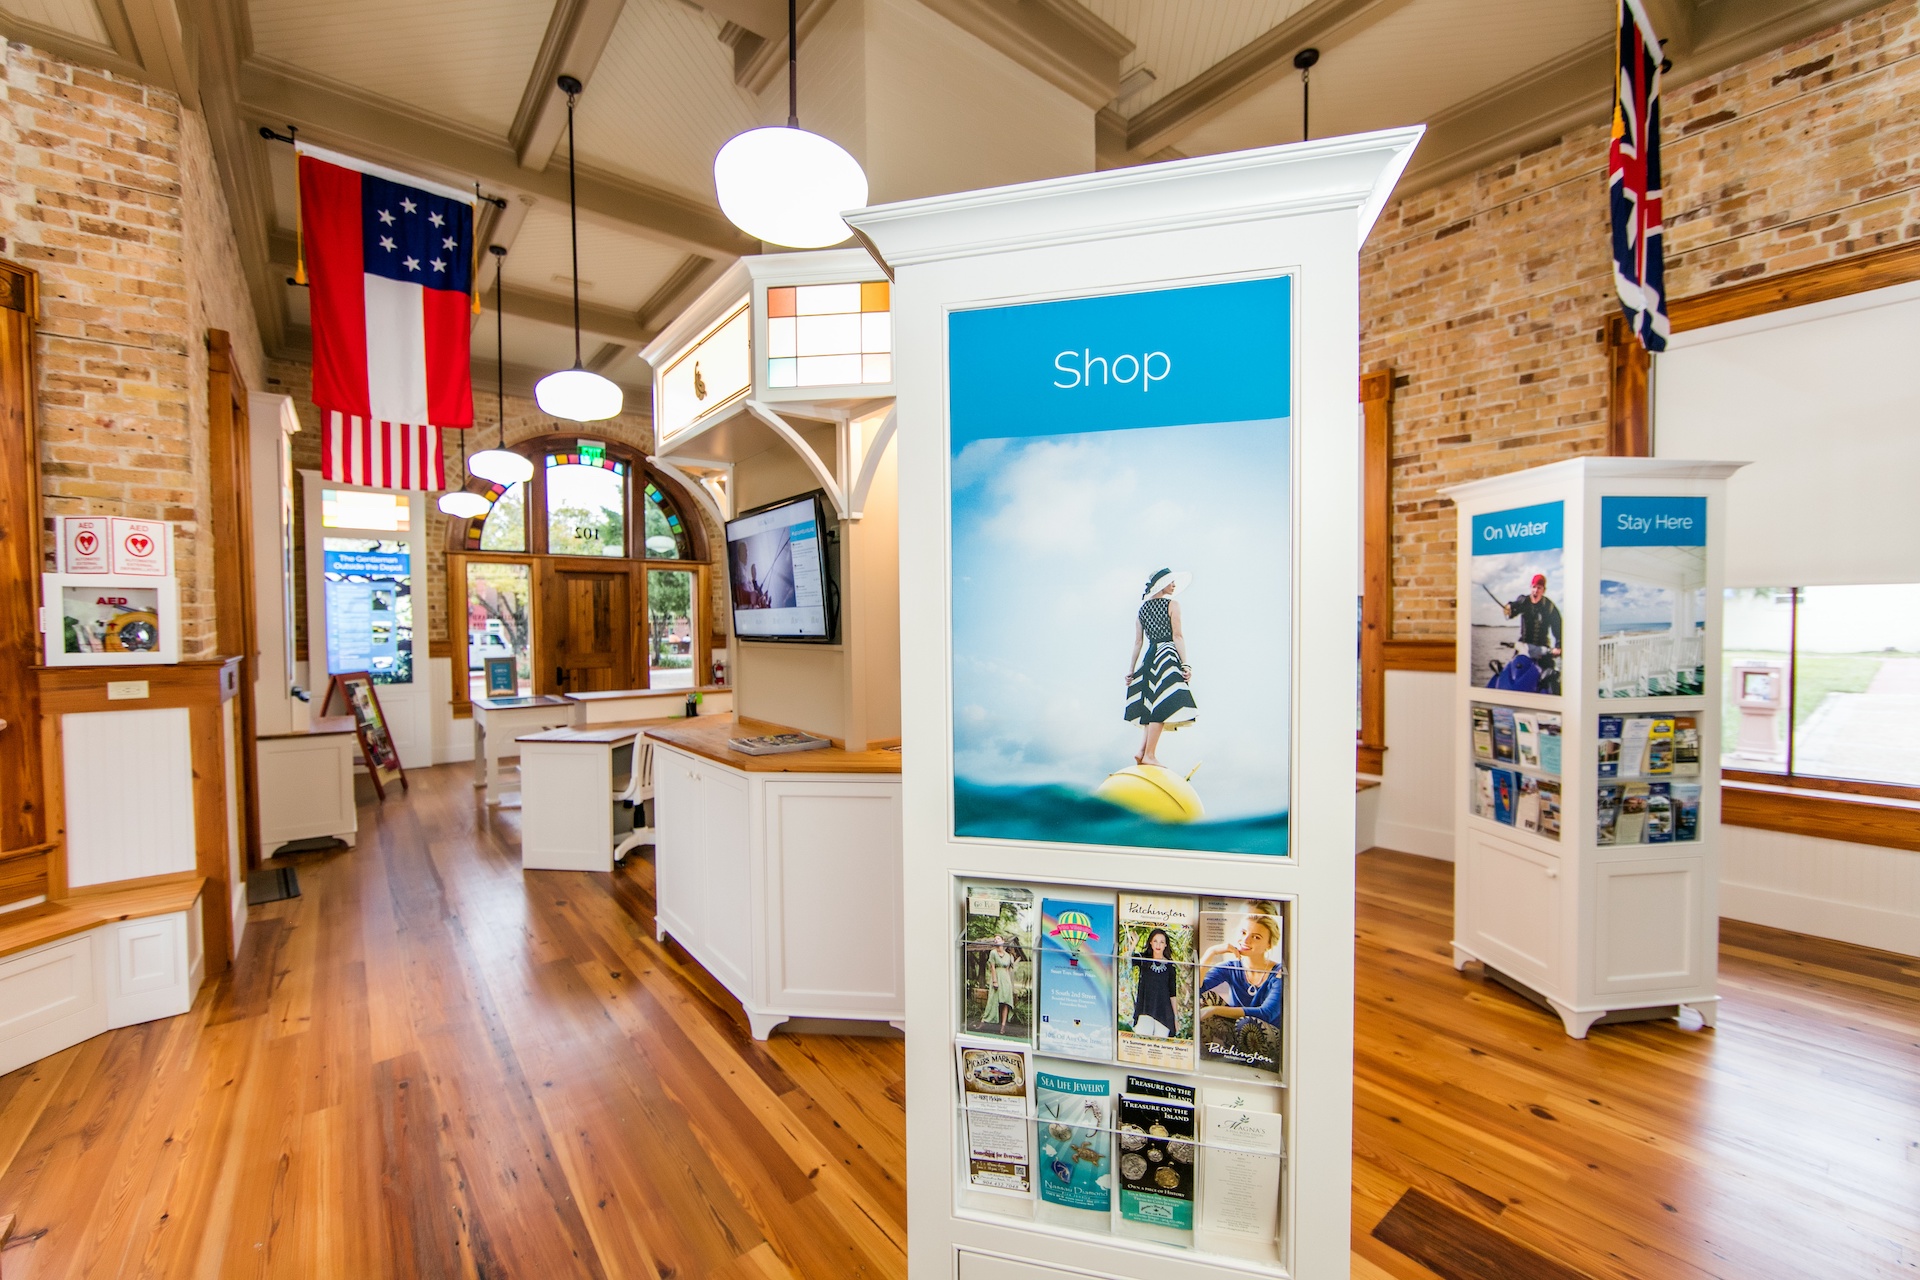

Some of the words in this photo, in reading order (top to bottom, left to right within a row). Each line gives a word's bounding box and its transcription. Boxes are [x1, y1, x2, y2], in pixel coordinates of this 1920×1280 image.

[1053, 348, 1171, 392] Shop
[1483, 524, 1503, 541] On
[1505, 520, 1548, 539] Water
[1617, 514, 1653, 534] Stay
[1656, 514, 1693, 530] Here
[338, 554, 356, 562] The
[356, 555, 398, 564] Gentleman
[333, 562, 364, 570] Outside
[365, 563, 378, 571] the
[379, 564, 404, 572] Depot
[96, 597, 128, 605] AED
[1126, 902, 1186, 920] Patchington
[1205, 1042, 1274, 1064] Patchington
[991, 1054, 1022, 1070] MARKET
[1041, 1076, 1054, 1087] SEA
[1057, 1080, 1071, 1090] LIFE
[1073, 1082, 1105, 1093] JEWELRY
[1130, 1078, 1164, 1090] TREASURE
[1123, 1101, 1160, 1110] TREASURE
[1164, 1113, 1189, 1122] ISLAND
[1218, 1119, 1266, 1134] MAGNA'S
[974, 1150, 995, 1158] Something
[1045, 1180, 1072, 1192] Nassau
[1074, 1186, 1108, 1196] Diamond
